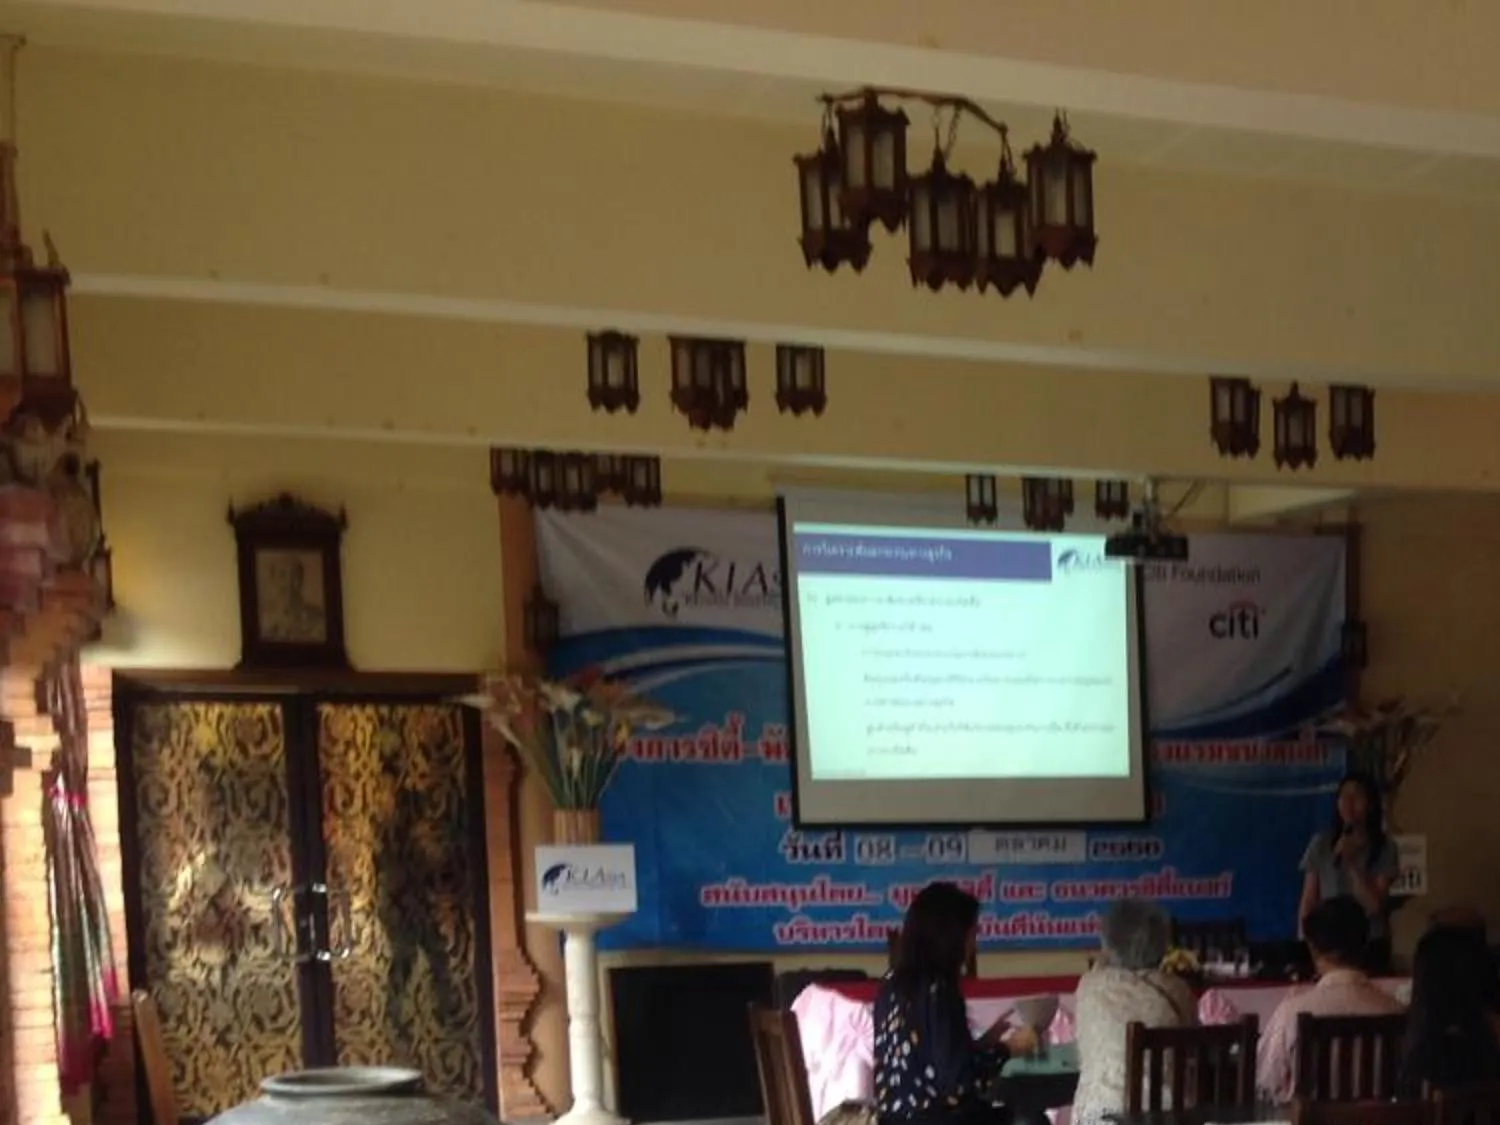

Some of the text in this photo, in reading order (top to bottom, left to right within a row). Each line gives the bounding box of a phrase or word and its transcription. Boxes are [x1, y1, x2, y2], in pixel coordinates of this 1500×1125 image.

[1172, 563, 1262, 583] Foundation
[1208, 600, 1260, 640] citi
[857, 836, 893, 861] 08
[928, 835, 963, 860] 09
